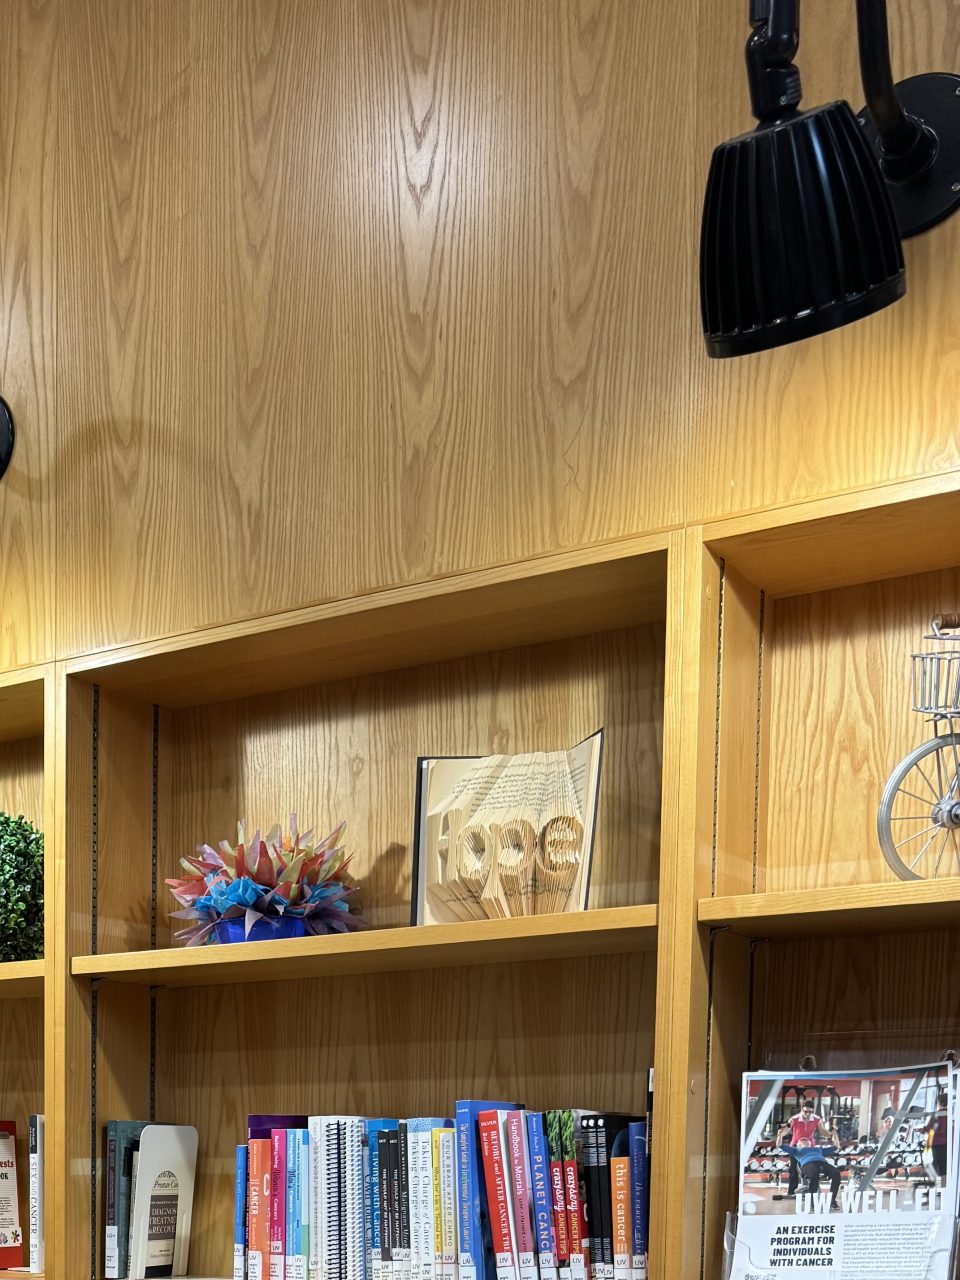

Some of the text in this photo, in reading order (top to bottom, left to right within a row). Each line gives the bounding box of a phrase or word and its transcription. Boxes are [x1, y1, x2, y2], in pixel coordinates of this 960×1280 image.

[533, 1155, 546, 1205] PLANET
[552, 1167, 564, 1212] crazysexy
[616, 1164, 628, 1241] this is cancer
[795, 1192, 833, 1215] UW
[775, 1225, 835, 1235] AN EXERCISE
[770, 1236, 835, 1246] PROGRAM FOR
[772, 1247, 832, 1256] INDIVIDUALS
[769, 1258, 833, 1267] WITH CANCER
